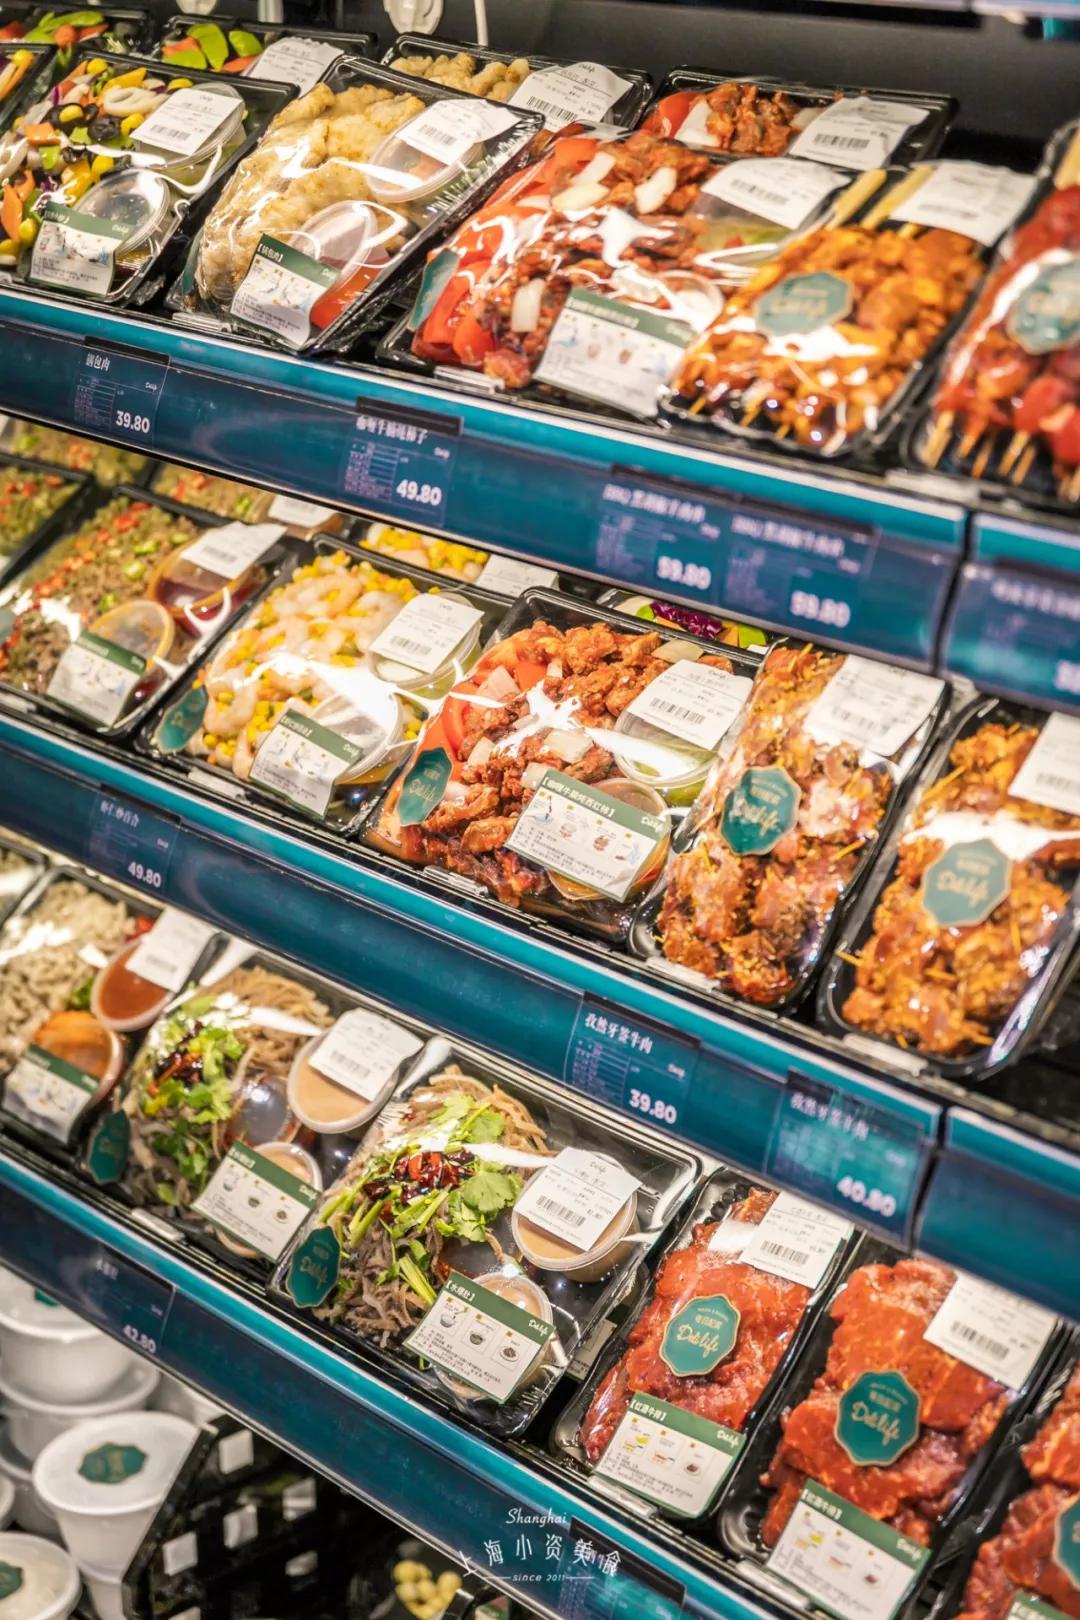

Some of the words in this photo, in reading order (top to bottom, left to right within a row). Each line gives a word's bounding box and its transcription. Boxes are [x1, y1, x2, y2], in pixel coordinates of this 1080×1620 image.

[115, 409, 151, 434] 39.80
[396, 478, 443, 506] 49.80
[127, 861, 162, 888] 49.80
[628, 1088, 677, 1125] 39.80
